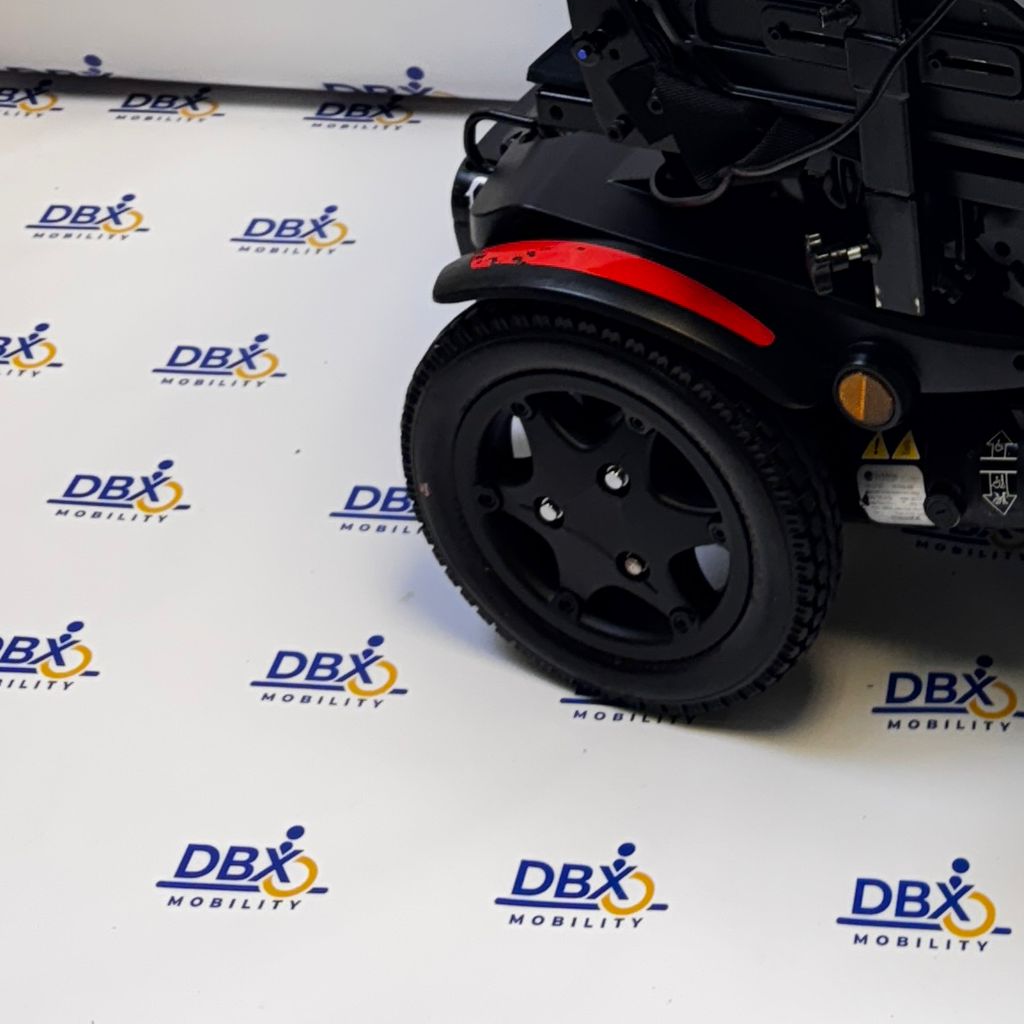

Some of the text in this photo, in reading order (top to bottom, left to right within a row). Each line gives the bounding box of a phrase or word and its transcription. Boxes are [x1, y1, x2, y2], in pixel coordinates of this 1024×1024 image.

[123, 94, 202, 111] DBX
[317, 102, 400, 118] DBX
[39, 205, 131, 225] DBX
[244, 218, 334, 238] DBX
[166, 346, 265, 370] DBX
[161, 378, 264, 387] MOBILITY
[63, 475, 170, 502] DBX
[345, 485, 413, 513] DB
[56, 509, 167, 523] MOBILITY
[0, 635, 80, 667] BX
[266, 651, 383, 684] DBX
[5, 679, 74, 690] ILITY
[885, 672, 997, 706] DBX
[261, 693, 383, 708] MOBILITY
[887, 719, 1010, 732] MOBILITY
[174, 844, 303, 883] DBX
[511, 860, 637, 900] DBX
[167, 896, 301, 910] MOBILITY
[852, 878, 974, 922] DBX
[509, 914, 643, 928] MOBILITY
[854, 933, 988, 952] MOBILITY
